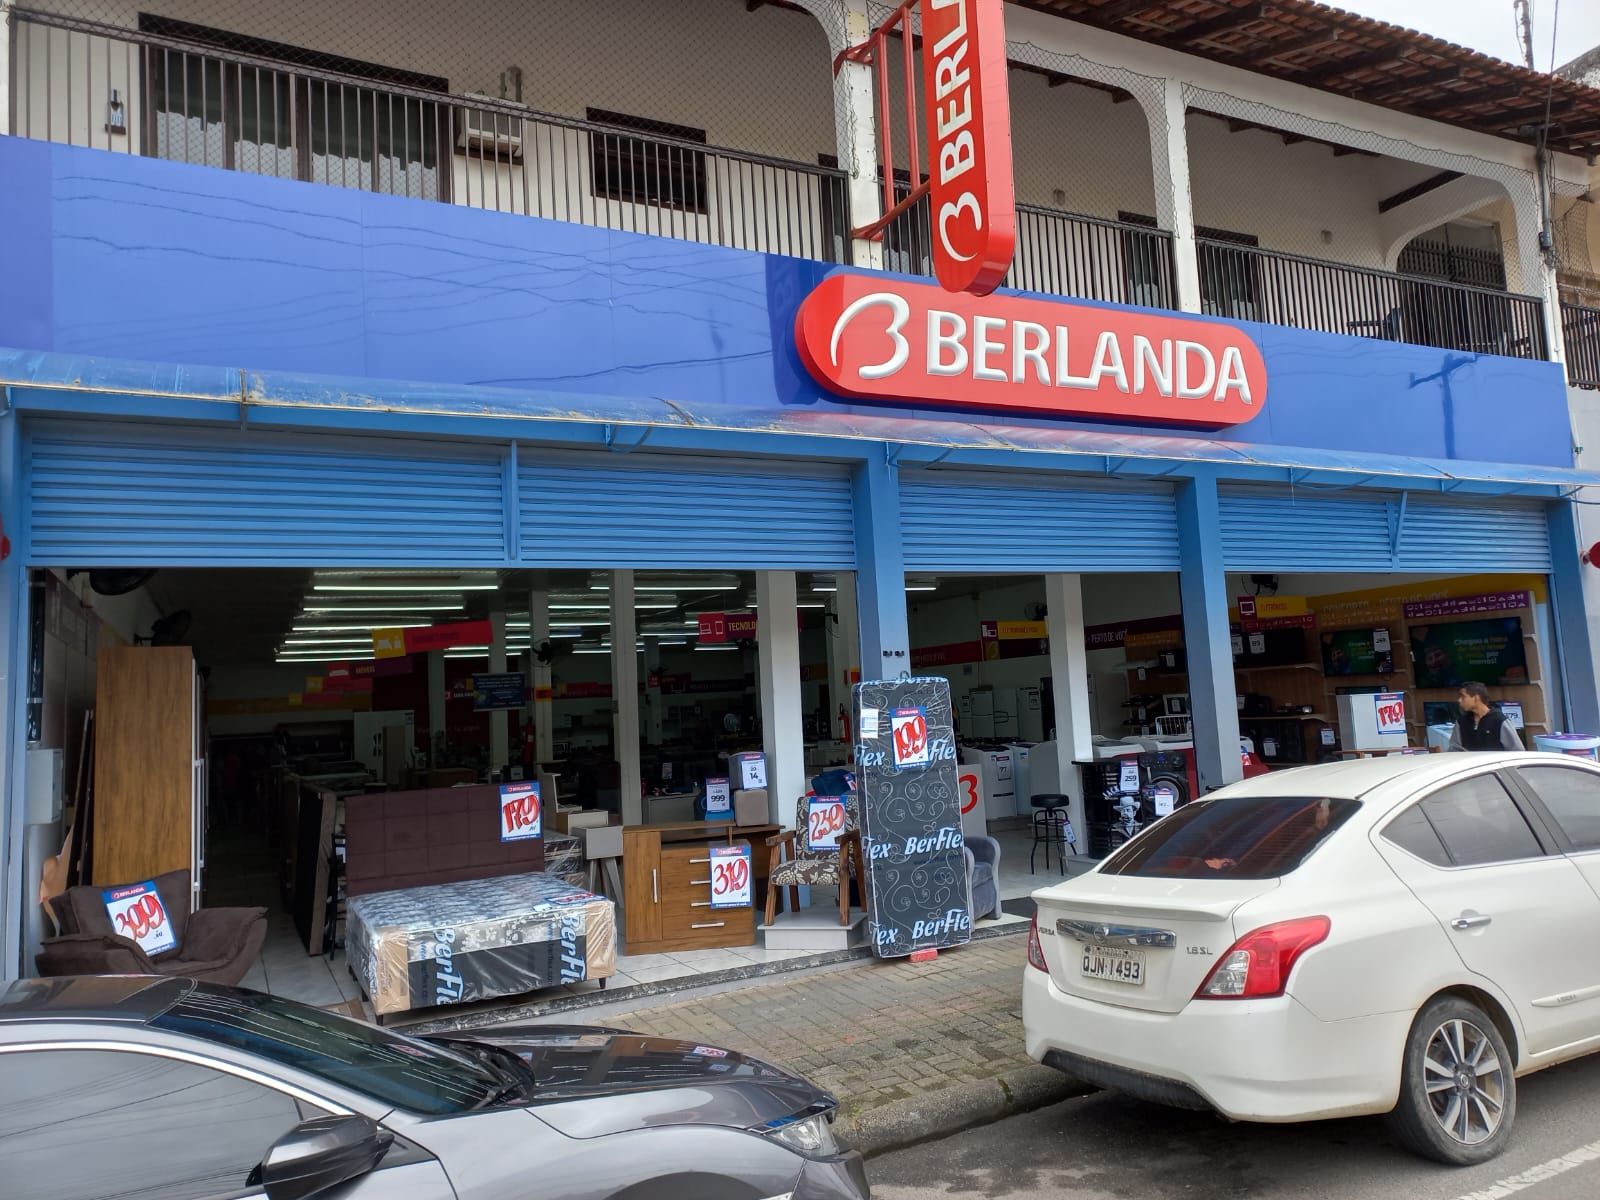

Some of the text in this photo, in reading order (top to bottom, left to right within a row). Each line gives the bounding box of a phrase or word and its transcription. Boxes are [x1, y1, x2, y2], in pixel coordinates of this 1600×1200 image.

[932, 0, 977, 187] BERL
[926, 309, 1253, 405] BERLANDA
[893, 715, 927, 762] 199
[929, 737, 957, 761] Fle
[710, 794, 726, 803] 999
